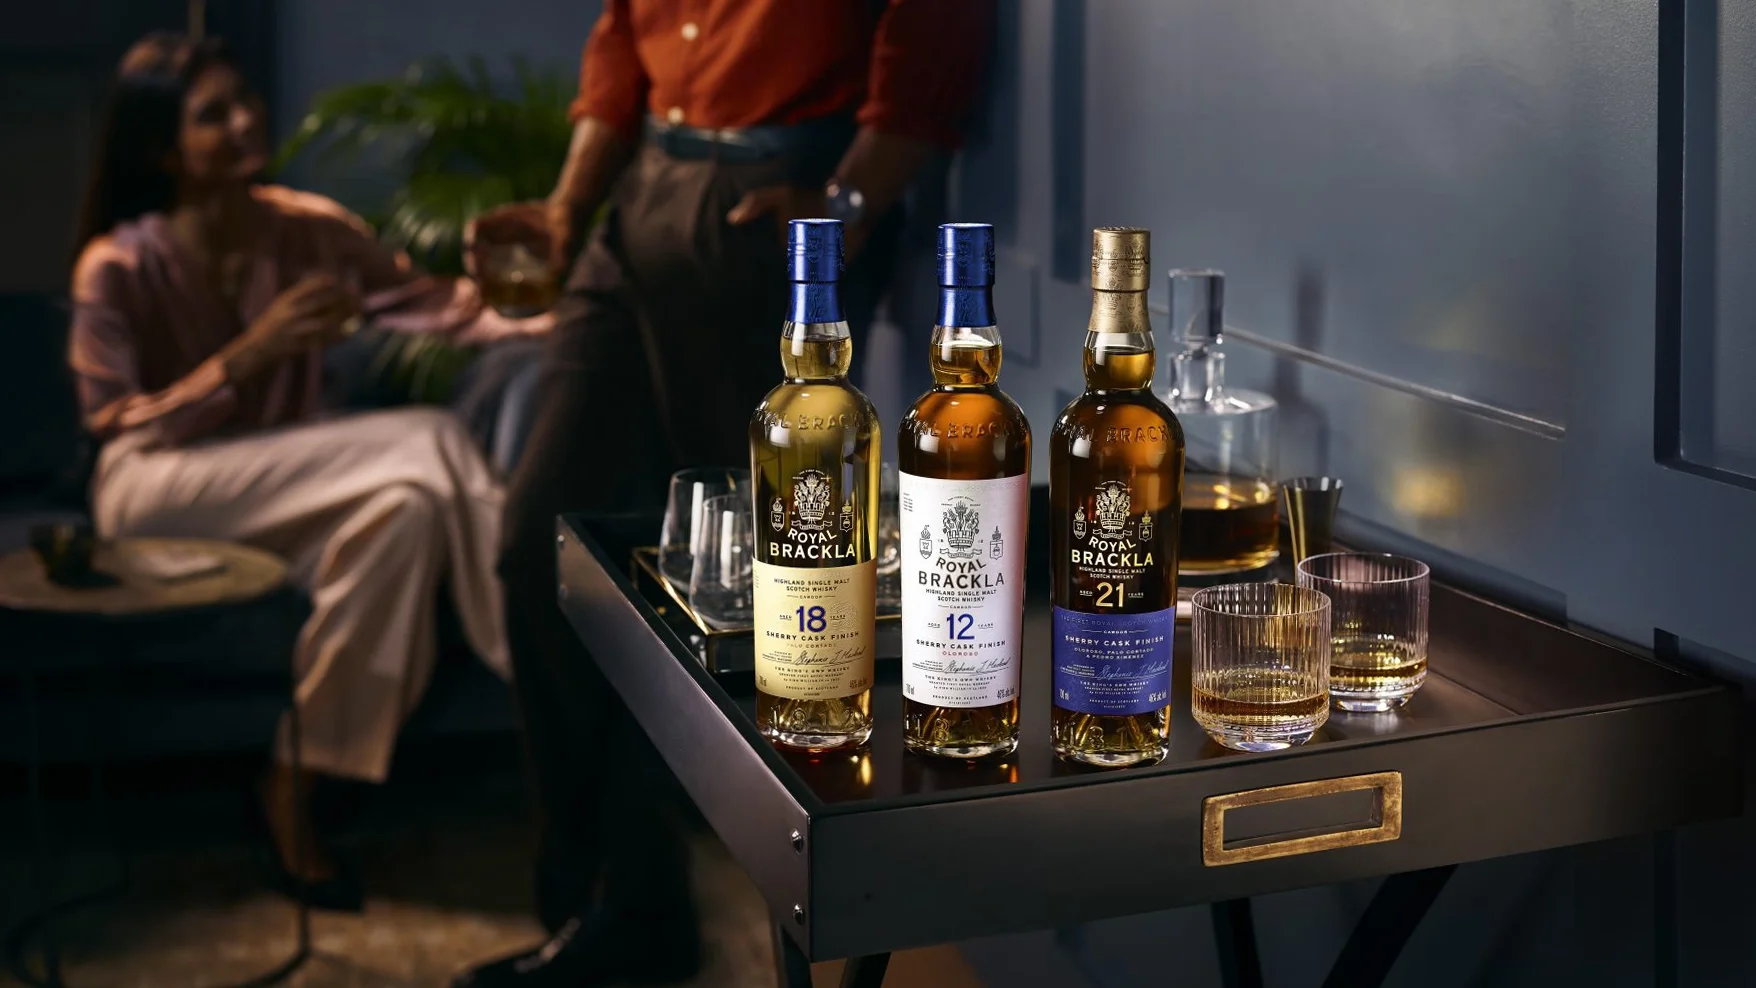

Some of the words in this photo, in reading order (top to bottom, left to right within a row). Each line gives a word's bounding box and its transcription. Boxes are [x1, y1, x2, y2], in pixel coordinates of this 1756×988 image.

[1107, 425, 1168, 444] BRACK
[788, 528, 837, 544] ROYAL
[1089, 536, 1136, 552] ROYAL
[770, 542, 855, 559] BRACKLA
[1072, 549, 1153, 566] BRACKLA
[936, 557, 986, 573] ROYAL
[774, 578, 805, 586] HIGHLAND
[919, 571, 1005, 589] BRACKLA
[1096, 582, 1124, 607] 21
[796, 606, 826, 632] 18
[946, 614, 975, 640] 12
[767, 631, 797, 640] SHERRY
[831, 631, 859, 640] FINISH
[917, 639, 946, 648] SHERRY
[979, 640, 1006, 648] FINISH
[1066, 636, 1099, 645] SHERRY
[1136, 636, 1164, 645] FINISH
